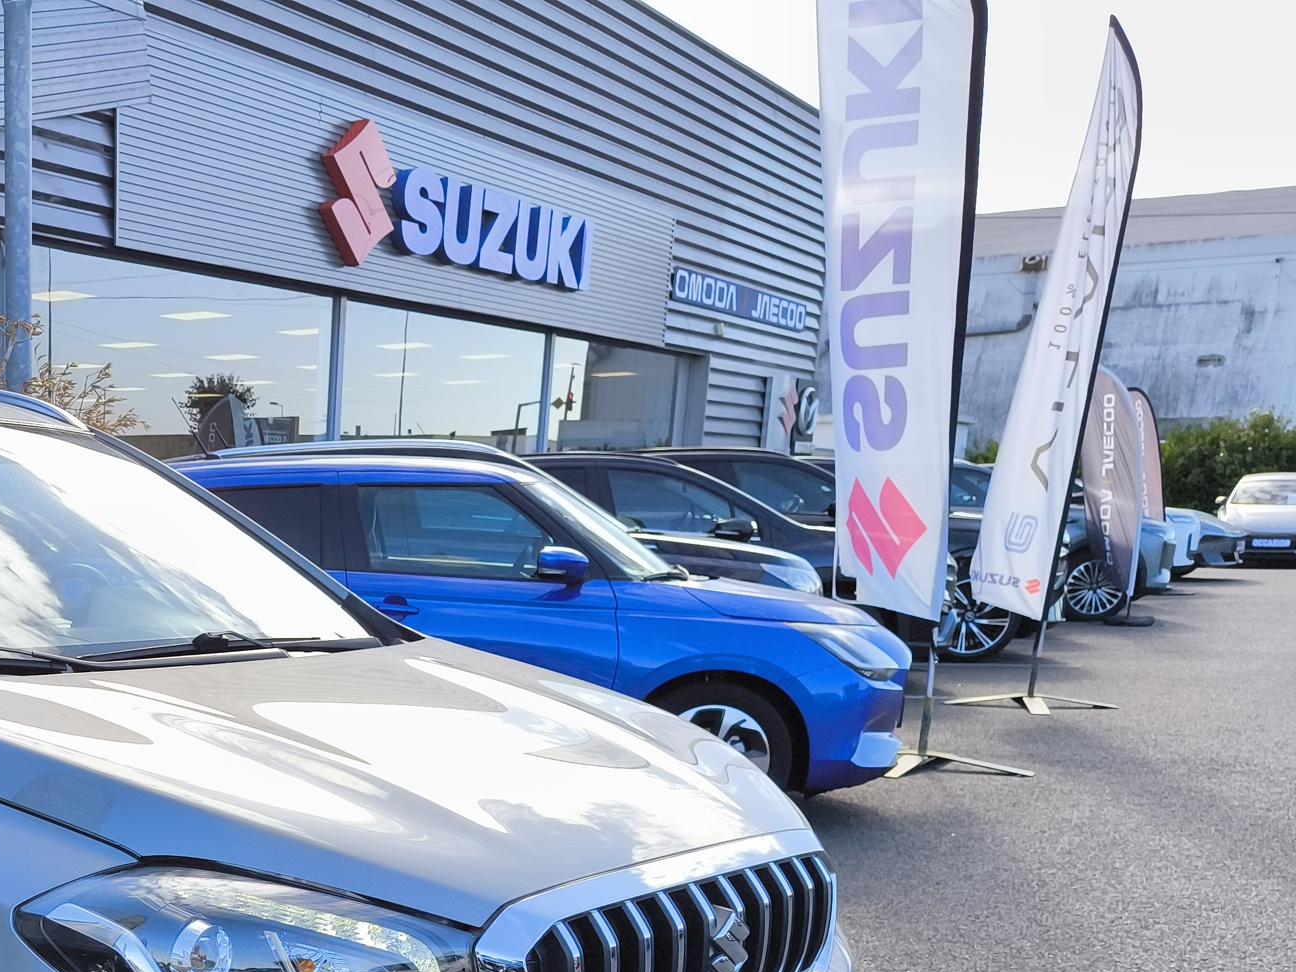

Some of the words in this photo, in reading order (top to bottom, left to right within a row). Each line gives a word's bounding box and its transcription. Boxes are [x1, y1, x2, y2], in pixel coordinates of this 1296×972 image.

[397, 166, 594, 291] SUZUKI
[675, 269, 737, 312] OMODA
[751, 293, 806, 330] JAECOO
